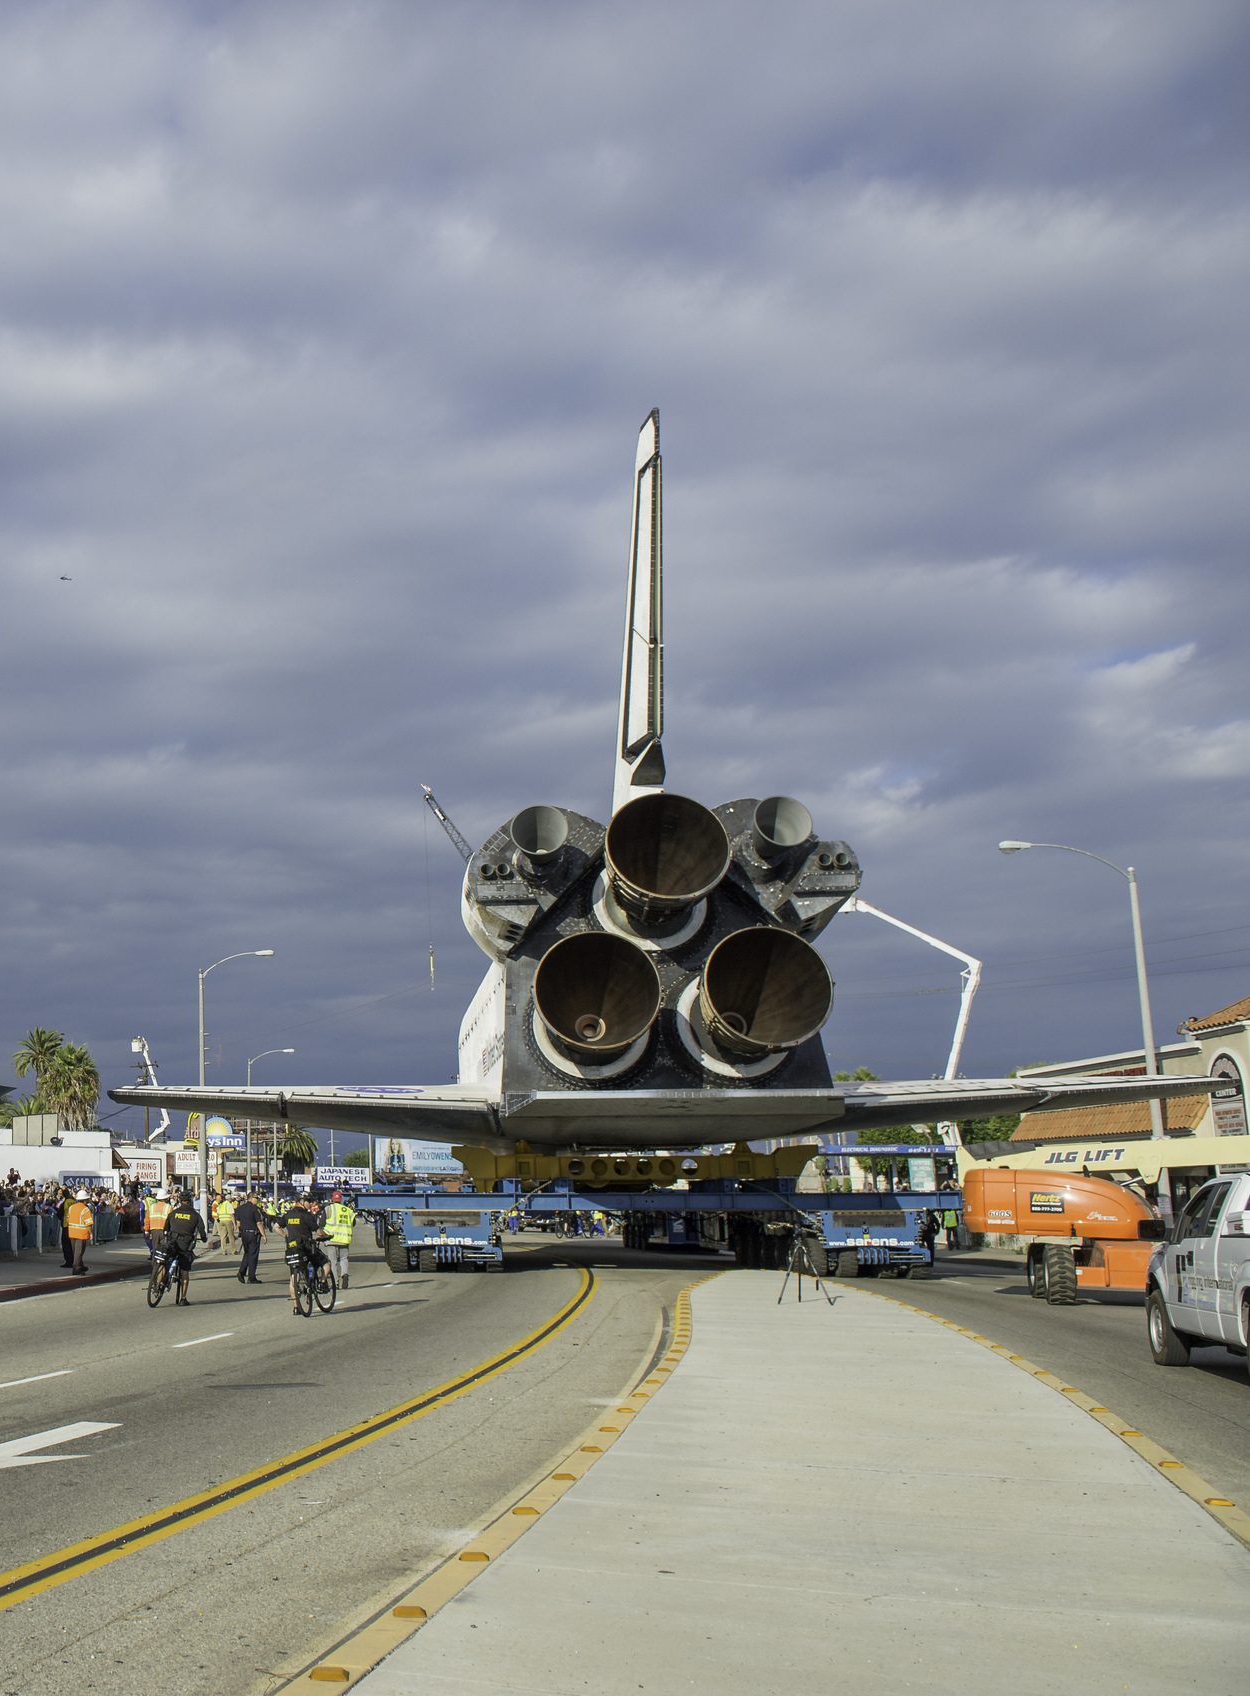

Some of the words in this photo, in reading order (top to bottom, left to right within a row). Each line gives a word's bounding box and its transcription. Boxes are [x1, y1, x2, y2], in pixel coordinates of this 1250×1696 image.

[222, 1137, 242, 1146] Inn
[177, 1153, 196, 1161] ADULT
[1044, 1150, 1079, 1165] JLG
[1082, 1148, 1126, 1162] LIFT
[136, 1162, 157, 1171] FIRING
[75, 1177, 90, 1189] CAR
[92, 1177, 113, 1189] WASH
[1031, 1193, 1062, 1203] Hertz
[174, 1212, 191, 1221] POLICE
[988, 1210, 1013, 1218] 600S
[407, 1237, 488, 1246] www.sarens.com
[828, 1237, 915, 1247] www.sarens.com
